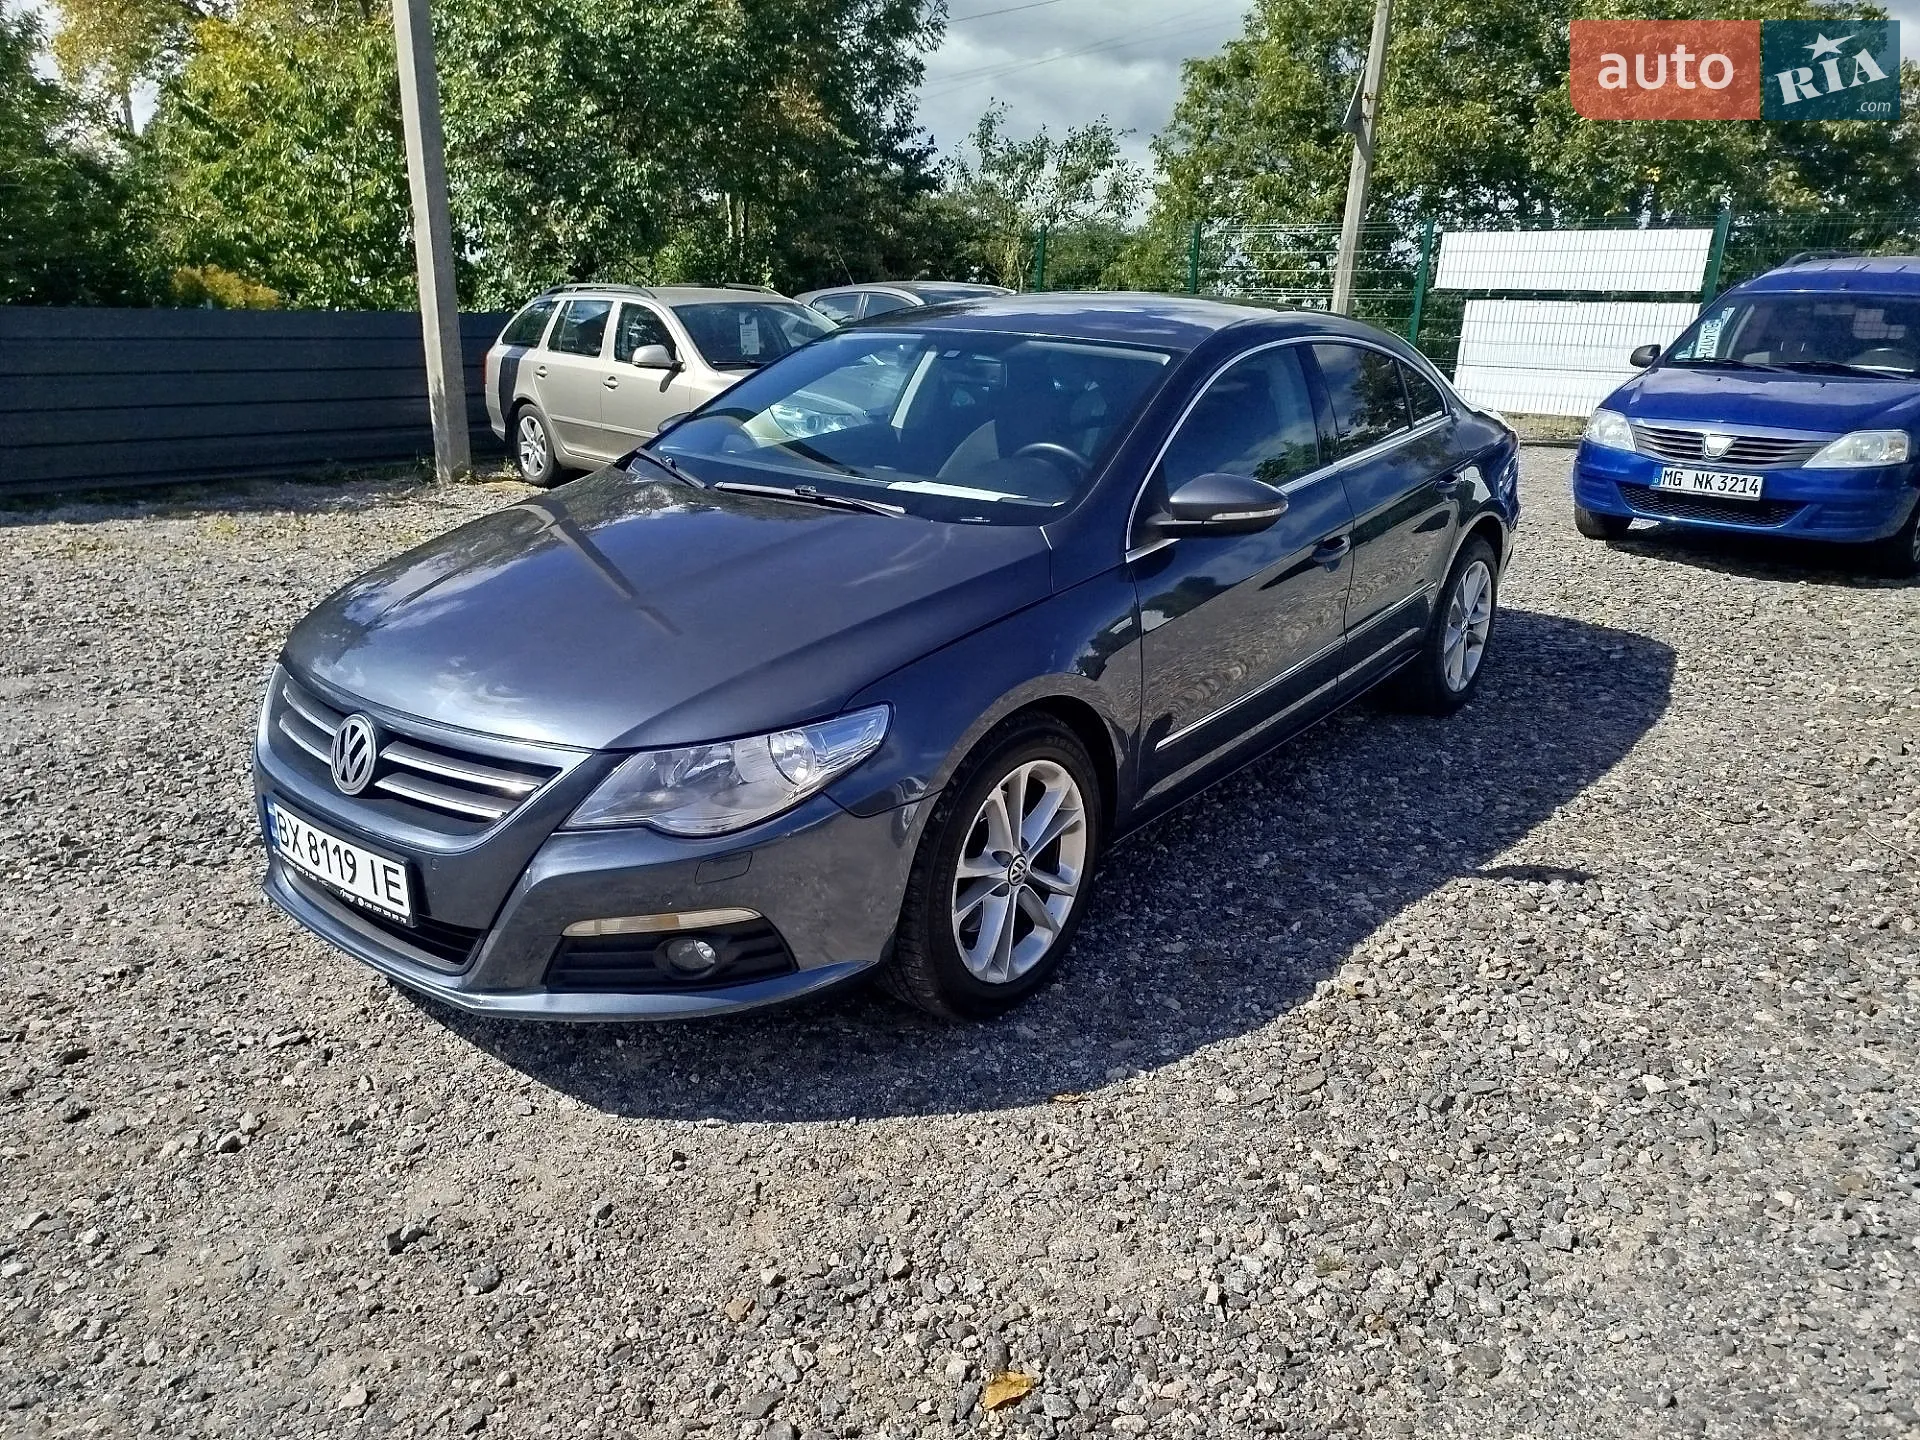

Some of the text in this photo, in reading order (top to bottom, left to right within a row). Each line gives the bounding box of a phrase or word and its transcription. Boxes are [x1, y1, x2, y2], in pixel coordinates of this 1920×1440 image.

[1662, 470, 1760, 495] MG NK 3214
[276, 811, 304, 859] BX
[307, 831, 357, 884] 8119
[370, 860, 404, 906] IE
